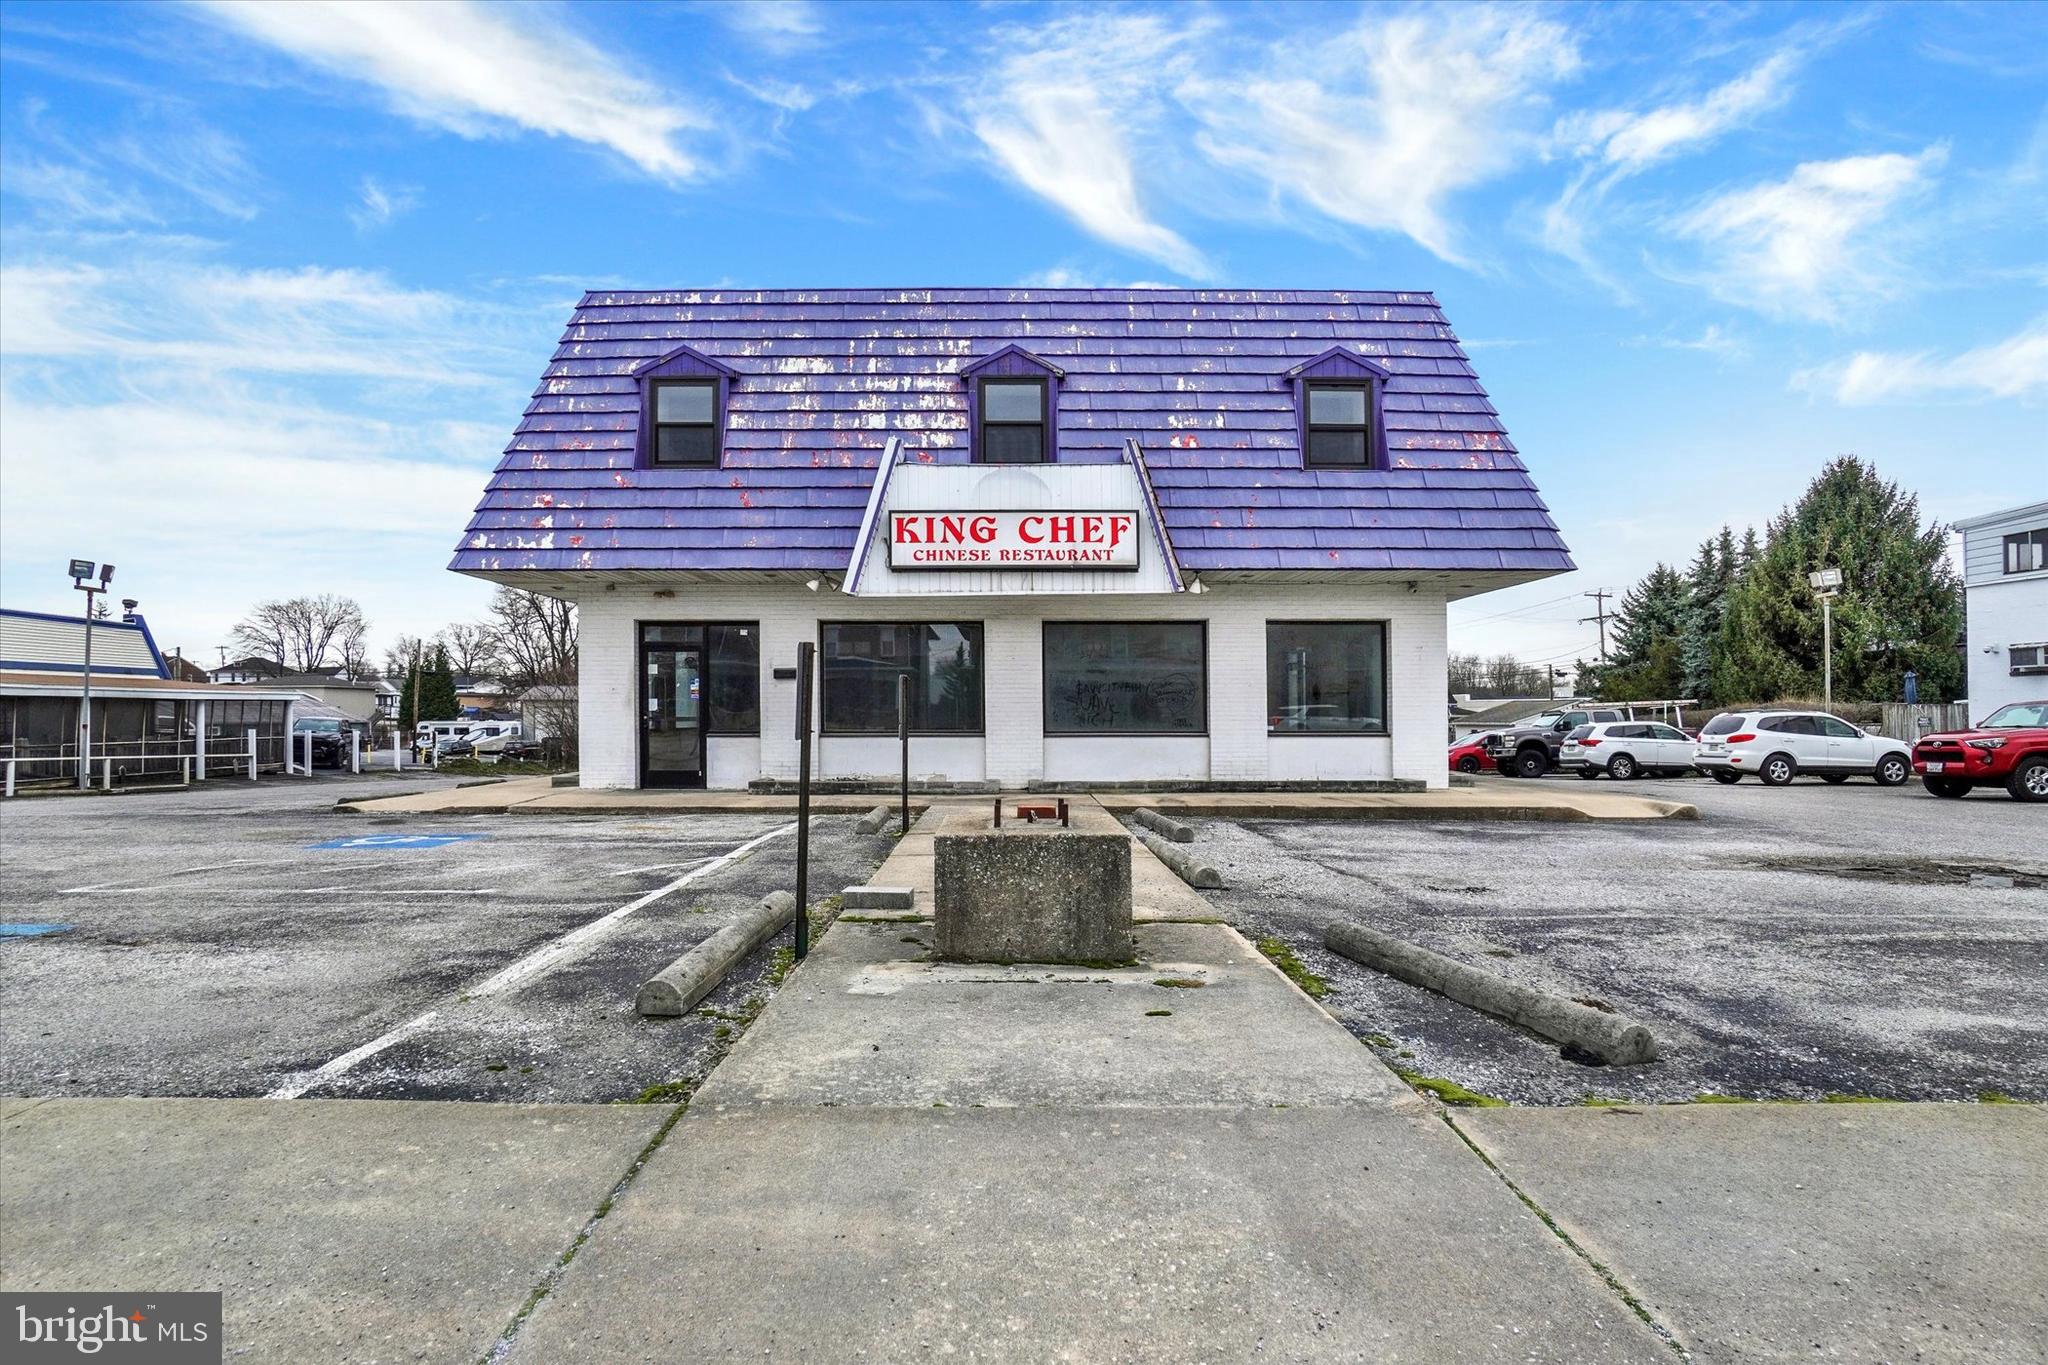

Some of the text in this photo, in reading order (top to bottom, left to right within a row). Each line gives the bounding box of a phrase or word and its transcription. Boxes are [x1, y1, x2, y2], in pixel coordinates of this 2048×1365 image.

[895, 516, 1131, 548] KING CHEF
[913, 549, 1114, 561] CHINESE RESTAURANT
